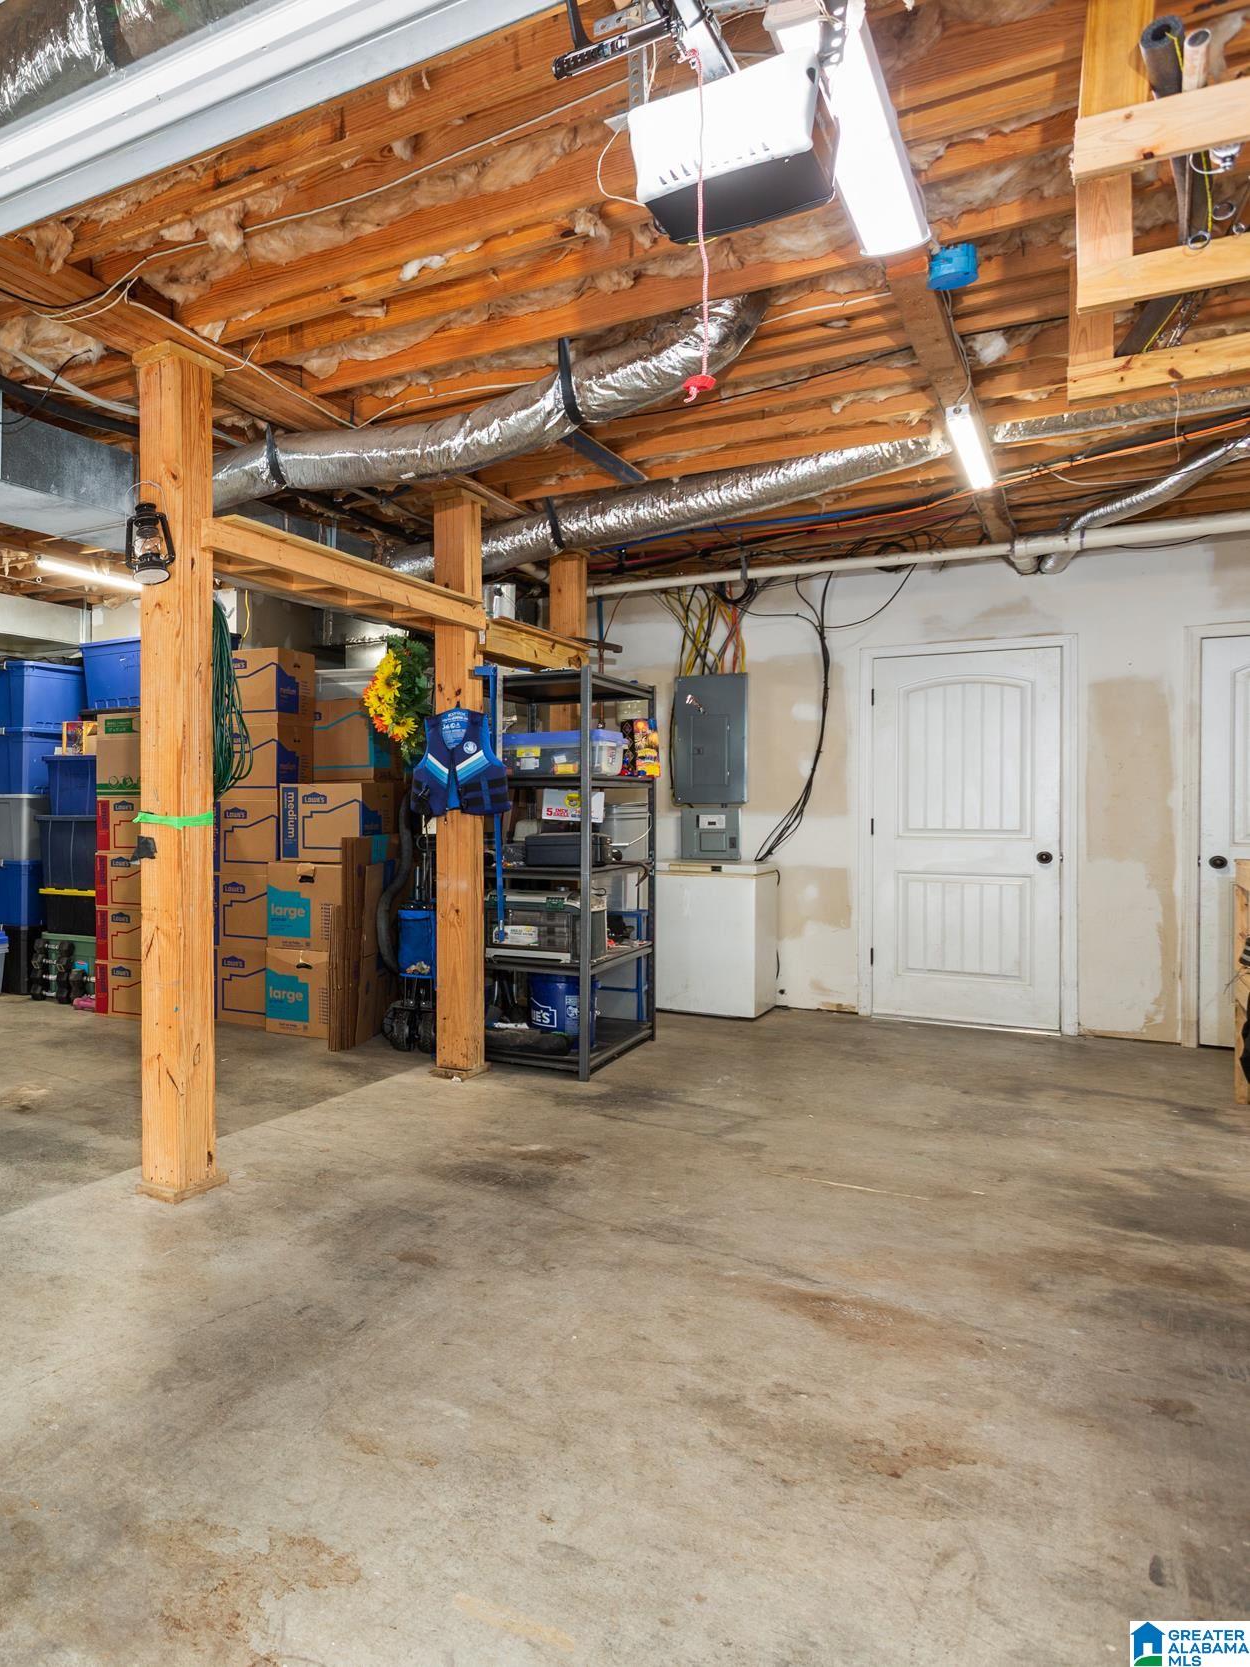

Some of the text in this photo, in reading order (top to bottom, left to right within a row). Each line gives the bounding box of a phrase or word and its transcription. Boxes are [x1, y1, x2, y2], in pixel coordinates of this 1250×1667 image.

[287, 792, 297, 839] medium
[546, 807, 553, 817] 5
[271, 903, 306, 920] large
[269, 986, 304, 1003] large
